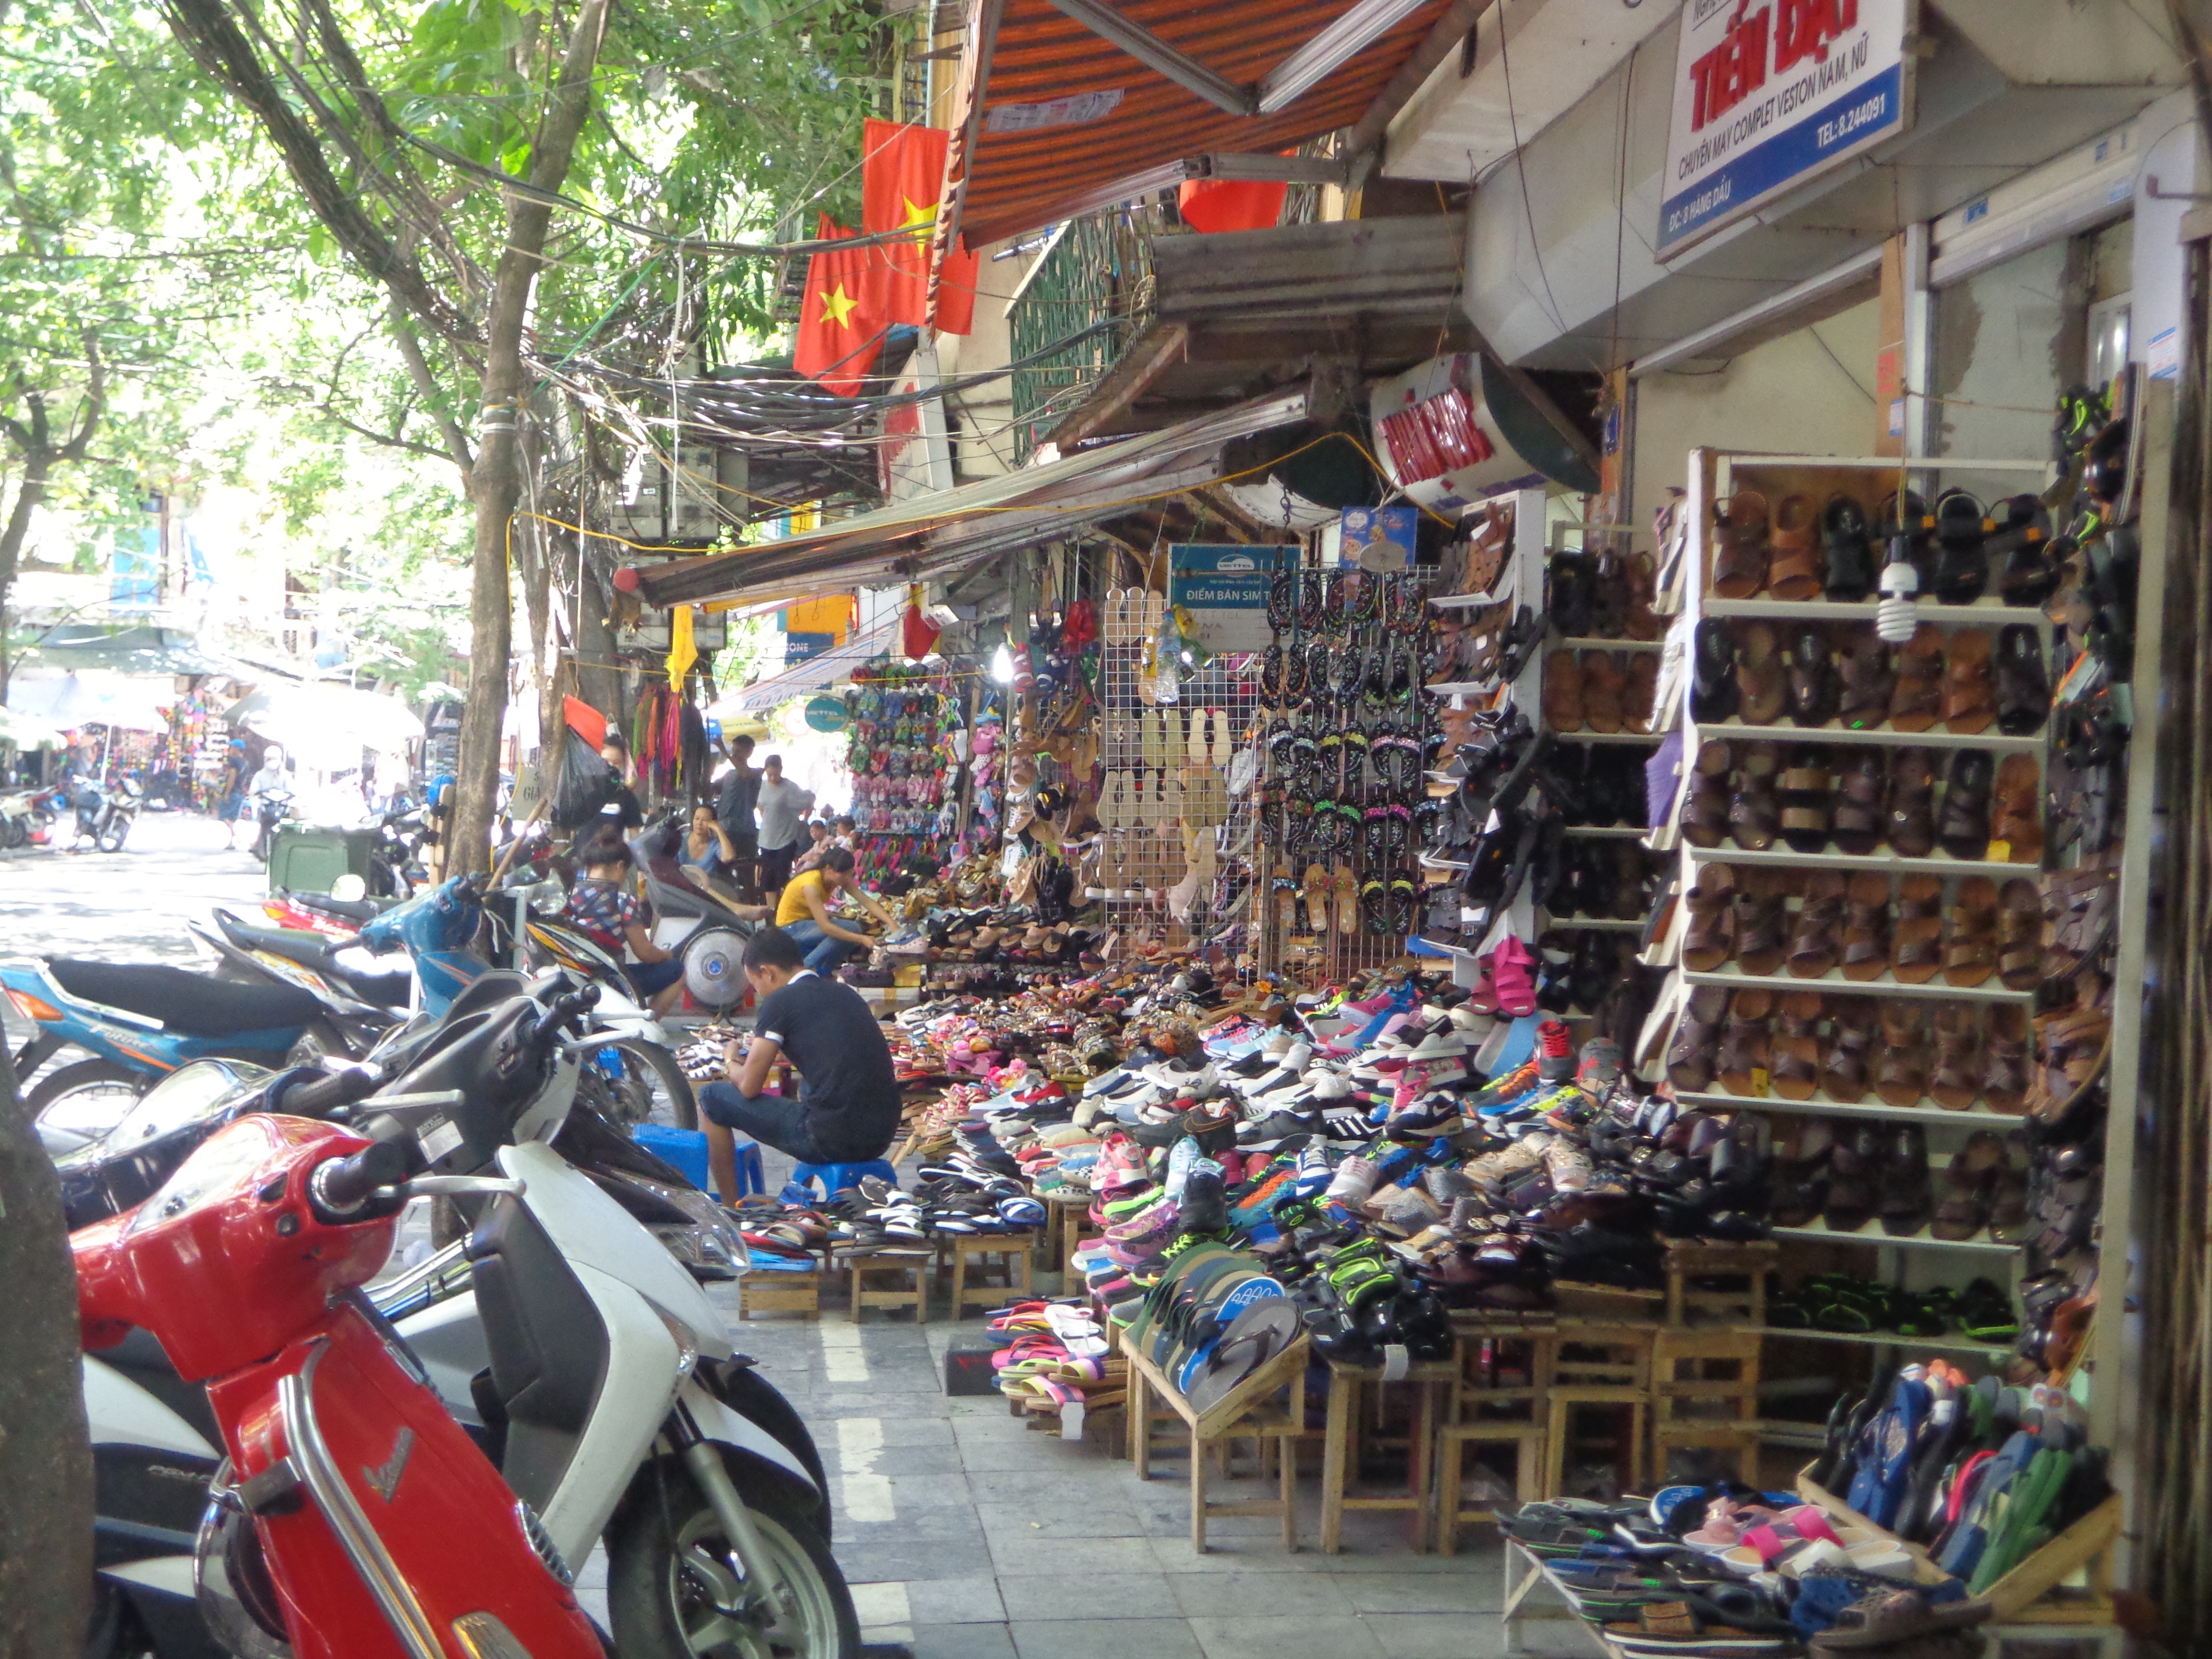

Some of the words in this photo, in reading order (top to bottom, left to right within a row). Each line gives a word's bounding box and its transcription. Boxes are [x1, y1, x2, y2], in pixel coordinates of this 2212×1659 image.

[1713, 125, 1732, 160] MAY
[1734, 97, 1775, 145] COMPLET
[1777, 72, 1816, 118] VESTON
[1186, 587, 1214, 600] ĐIỂM
[1217, 589, 1239, 600] BÁN
[1242, 590, 1261, 600] SIM
